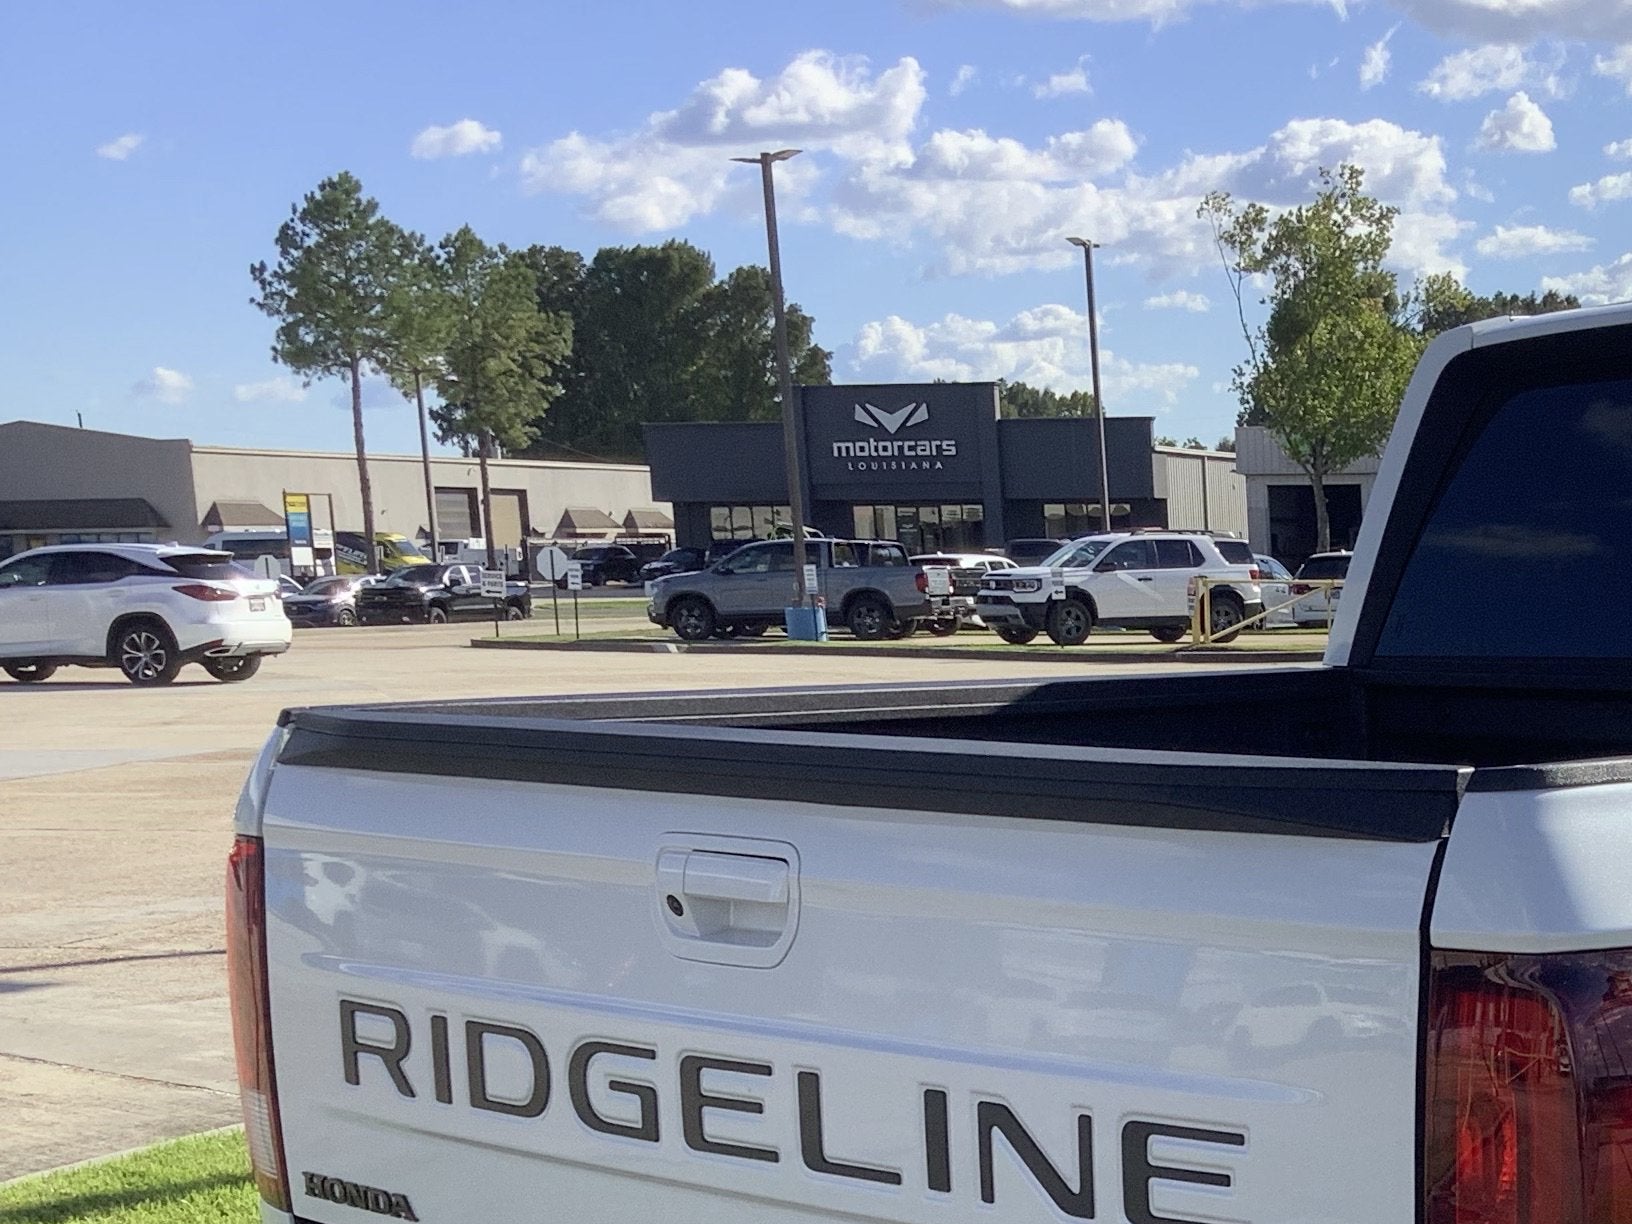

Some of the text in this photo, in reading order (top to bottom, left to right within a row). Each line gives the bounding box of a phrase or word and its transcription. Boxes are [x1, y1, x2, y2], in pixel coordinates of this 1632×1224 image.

[832, 438, 957, 457] motorcars
[847, 461, 943, 471] LOUISIANA
[302, 1171, 419, 1222] HONDA
